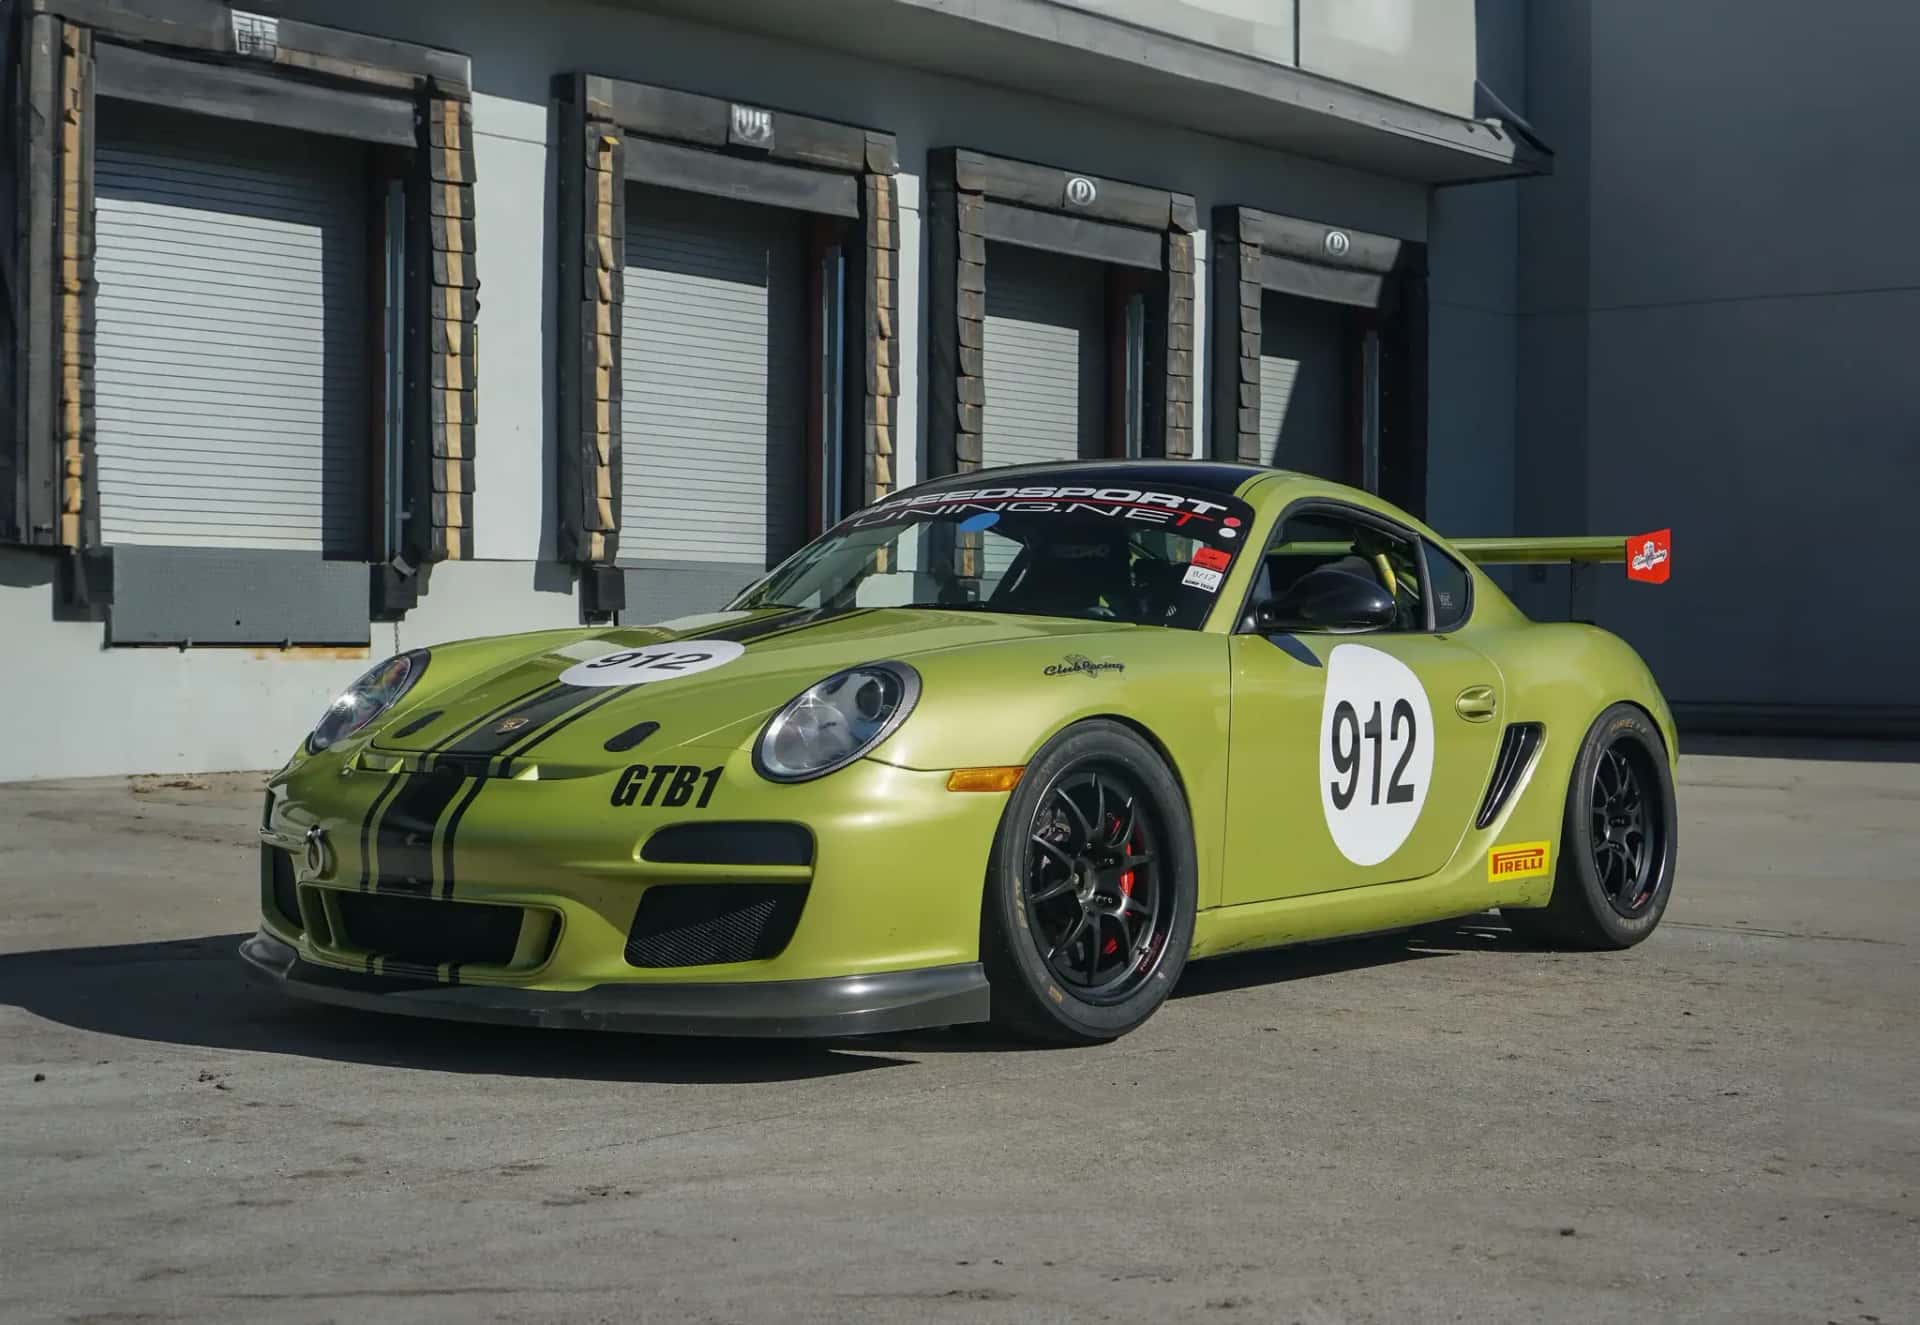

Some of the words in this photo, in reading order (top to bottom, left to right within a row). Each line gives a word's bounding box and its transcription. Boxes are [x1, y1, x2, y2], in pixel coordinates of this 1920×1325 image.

[586, 652, 713, 670] 912
[1043, 661, 1081, 676] Club
[1081, 661, 1125, 673] Racing
[1331, 698, 1417, 810] 912
[610, 764, 725, 809] GTB1
[1493, 848, 1545, 875] PIRELLI
